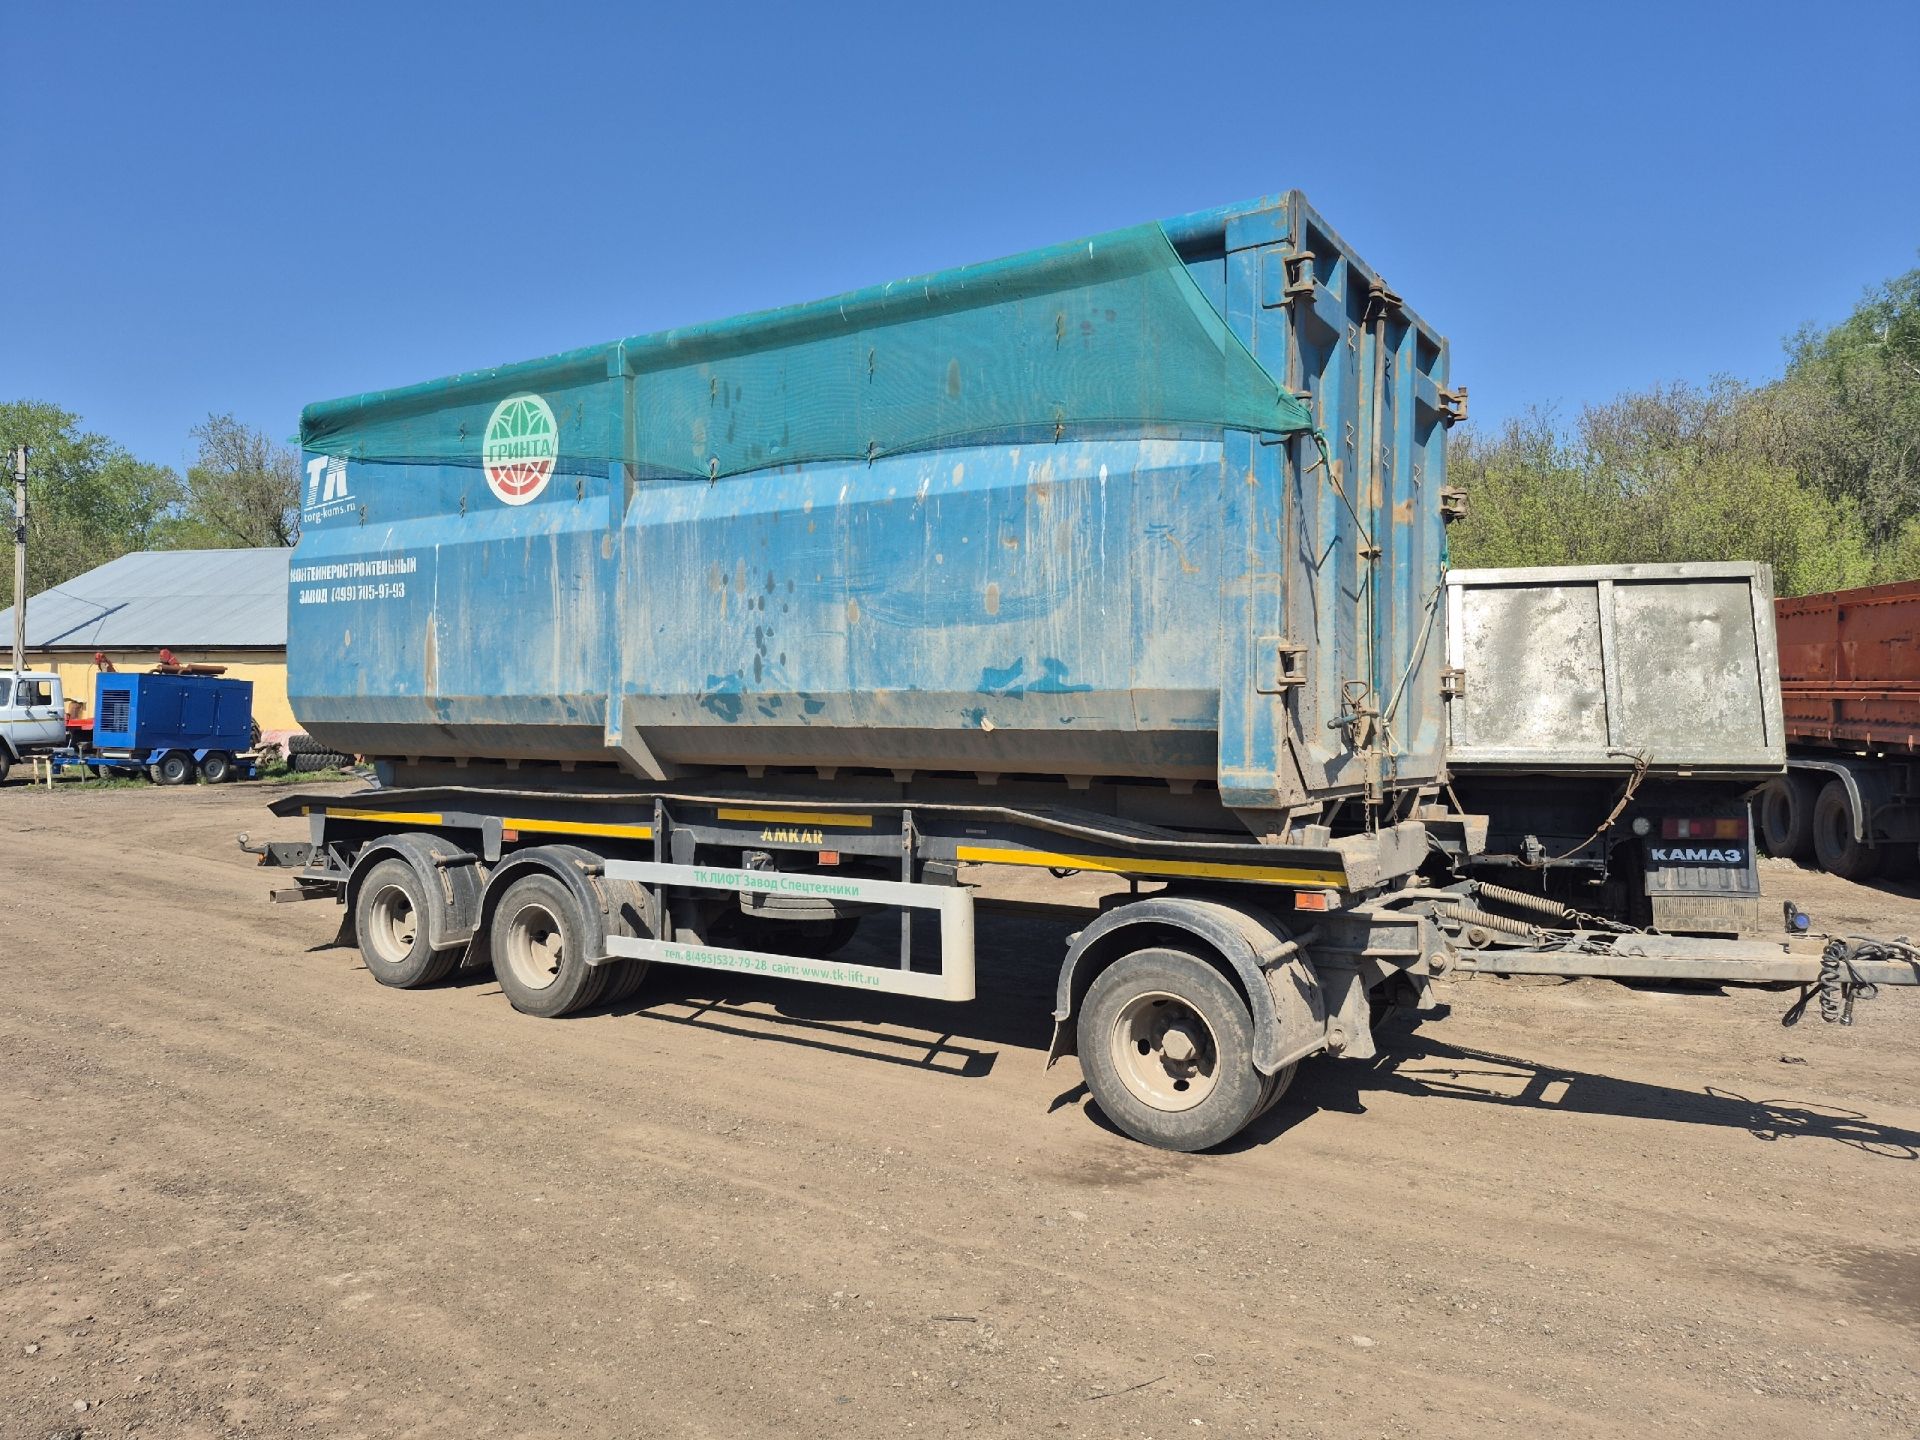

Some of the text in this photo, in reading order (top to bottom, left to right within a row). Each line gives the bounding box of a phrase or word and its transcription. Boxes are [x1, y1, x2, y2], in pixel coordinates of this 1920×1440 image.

[489, 439, 551, 462] ГРИНТА
[299, 588, 328, 604] ЗАВОД
[1651, 848, 1742, 862] КАМАЗ
[693, 870, 860, 896] ТК ЛИФТ Завод Спецтехники
[664, 949, 880, 986] тел. 8(495)532-79-28 сайт: www.tk-lift.ru
